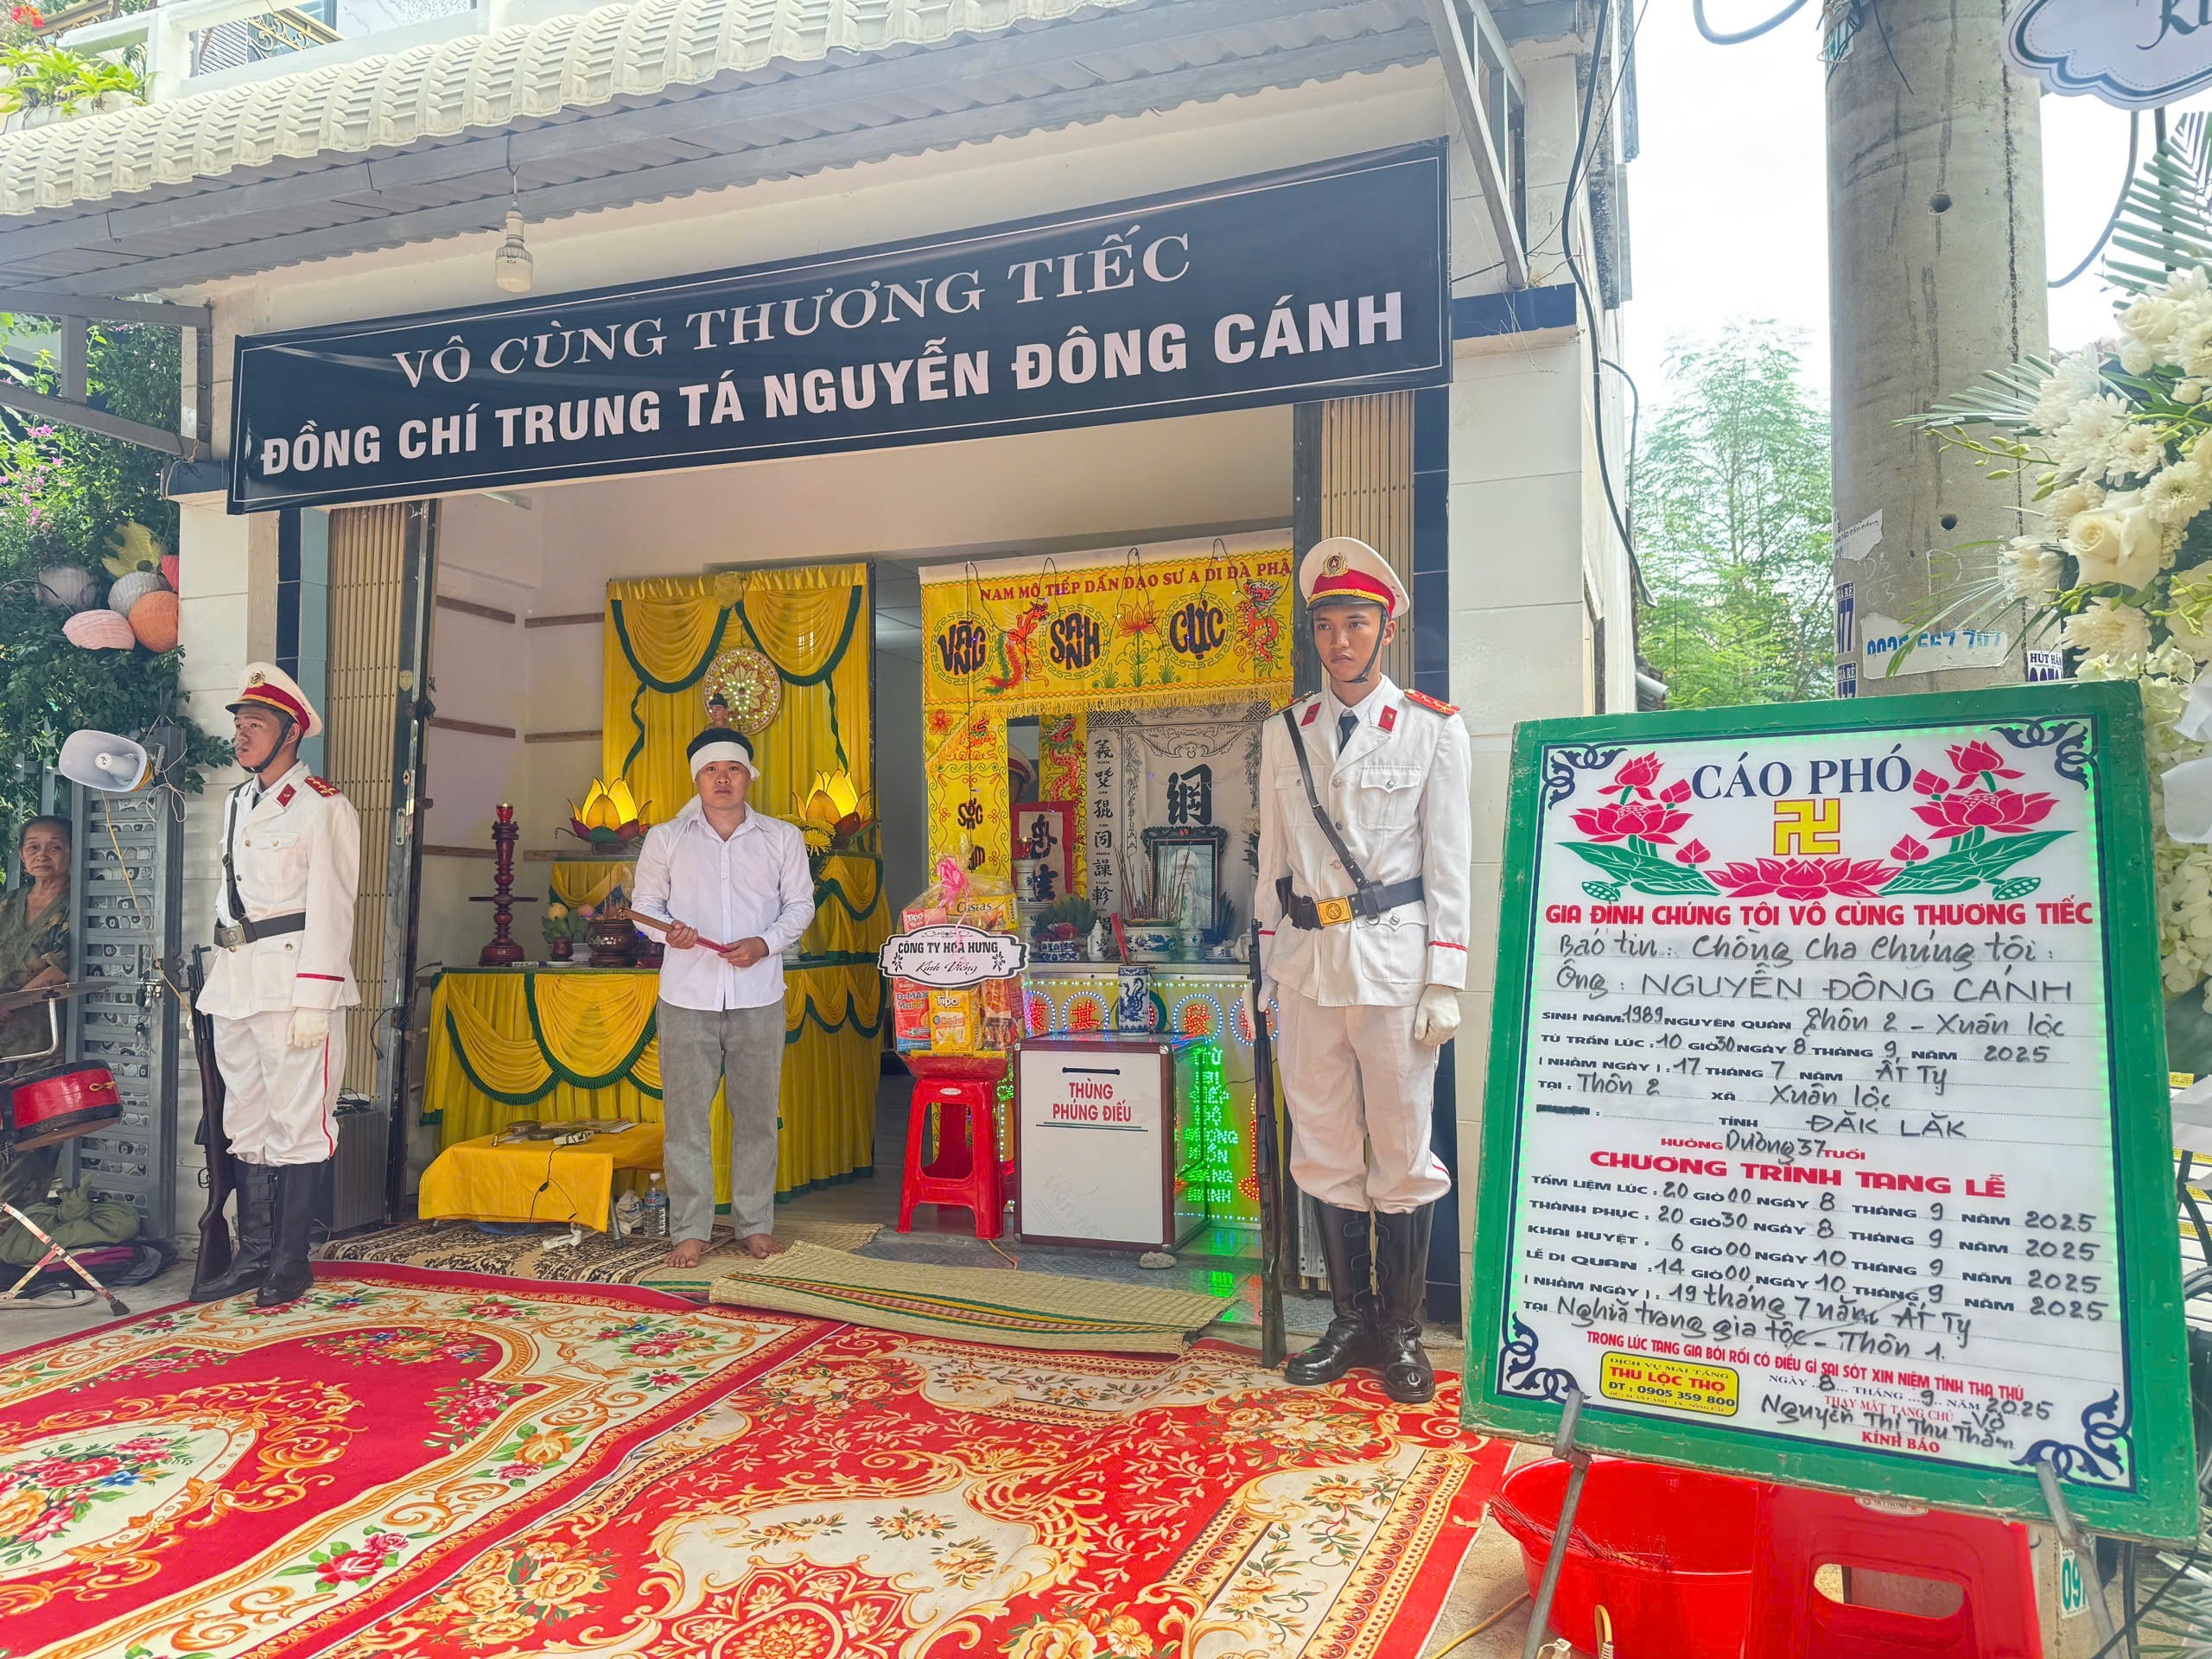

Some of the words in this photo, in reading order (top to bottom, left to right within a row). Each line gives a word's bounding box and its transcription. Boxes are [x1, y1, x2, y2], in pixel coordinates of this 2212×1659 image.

[392, 334, 469, 388] VÔ
[491, 318, 667, 375] CÙNG
[685, 270, 985, 351] THƯƠNG
[1007, 225, 1190, 304] TIẾC
[261, 419, 381, 475] ĐỒNG
[398, 404, 477, 460] CHÍ
[494, 391, 660, 448] TRUNG
[678, 370, 745, 427] TÁ
[763, 336, 989, 419] NGUYỄN
[1010, 325, 1187, 391] ĐÔNG
[1214, 291, 1402, 365] CÁNH
[981, 588, 1014, 601] NAM
[1045, 582, 1081, 596] TIẾP
[1124, 575, 1158, 591] ĐẠO
[1164, 569, 1184, 584] SƯ
[1189, 569, 1199, 583] A
[1205, 568, 1224, 582] DI
[1227, 562, 1251, 579] ĐÀ
[1257, 561, 1292, 576] PHẬ
[1169, 599, 1226, 659] CỰC
[2031, 652, 2049, 663] HÚT
[1692, 751, 1792, 799] CÁO
[1809, 744, 1911, 797] PHÓ
[906, 912, 924, 921] Tipo
[1546, 905, 1580, 924] GIA
[1590, 901, 1643, 925] ĐÌNH
[1652, 902, 1731, 925] CHÚNG
[1740, 901, 1779, 925] TÔI
[1789, 901, 1826, 925] VÔ
[1835, 901, 1904, 925] CÙNG
[1914, 902, 2025, 925] THƯƠNG
[2036, 894, 2094, 925] TIẾC
[899, 940, 924, 953] CÔNG
[927, 943, 940, 953] TY
[1560, 927, 1605, 957] Báo
[1985, 932, 2036, 962] tôi
[916, 961, 939, 976] Kính
[944, 962, 978, 975] Viếng
[1642, 963, 1802, 998] NGUYỄN
[1822, 971, 1934, 1001] ĐÔNG
[1954, 964, 2071, 1001] CÁNH
[936, 995, 958, 1006] Tipo
[1542, 1012, 1577, 1020] SINH
[1623, 1004, 1663, 1024] 1989
[1664, 1017, 1734, 1028] NGUYÊN
[1741, 1019, 1791, 1029] QUÁN
[1884, 1012, 1897, 1032] 2
[1936, 1013, 2008, 1035] Xuân
[1614, 1036, 1644, 1047] LÚC
[1656, 1033, 1682, 1050] 10
[1718, 1036, 1734, 1052] 30
[1737, 1043, 1787, 1054] NGÀY
[1793, 1038, 1805, 1054] 8
[1812, 1046, 1873, 1058] THÁNG
[1885, 1041, 1897, 1057] 9
[1911, 1050, 1957, 1060] NĂM
[1985, 1046, 2050, 1063] 2025
[1602, 1061, 1649, 1071] NGÀY
[1673, 1058, 1700, 1076] 17
[1705, 1067, 1763, 1077] THÁNG
[1771, 1061, 1784, 1079] 7
[1799, 1071, 1843, 1081] NĂM
[1069, 1078, 1113, 1099] THÙNG
[1578, 1073, 1632, 1093] Thôn
[1647, 1078, 1660, 1096] 2
[1770, 1083, 1838, 1105] Xuân
[1052, 1099, 1098, 1121] PHÚNG
[1103, 1099, 1132, 1122] ĐIẾU
[1797, 1138, 1826, 1158] 37
[1590, 1151, 1727, 1176] CHƯƠNG
[1740, 1160, 1842, 1186] TRÌNH
[1855, 1172, 1951, 1193] TANG
[1965, 1174, 2005, 1198] LỄ
[1573, 1179, 1611, 1192] LIỆM
[1617, 1183, 1648, 1195] LÚC
[1662, 1181, 1688, 1198] 20
[1728, 1187, 1751, 1205] 00
[1757, 1197, 1809, 1210] NGÀY
[1819, 1192, 1834, 1211] 8
[1852, 1205, 1917, 1218] THÁNG
[1930, 1203, 1943, 1221] 9
[1961, 1213, 2011, 1226] NĂM
[2024, 1211, 2096, 1232] 2025
[1523, 1301, 1548, 1313] TẠI
[1636, 1301, 1707, 1338] trang
[1713, 1316, 1756, 1341] gia
[1838, 1332, 1910, 1357] Thôn
[1587, 1331, 1624, 1348] TRONG
[1628, 1334, 1647, 1351] LÚC
[1651, 1339, 1680, 1355] TANG
[1684, 1344, 1702, 1358] GIA
[1753, 1351, 1770, 1368] CÓ
[1821, 1363, 1839, 1378] SAI
[1843, 1365, 1866, 1381] SÓT
[1872, 1369, 1894, 1384] XIN
[1968, 1381, 1993, 1397] THA
[1609, 1382, 1625, 1390] ĐT
[1637, 1385, 1672, 1397] 0905
[1677, 1391, 1702, 1402] 359
[1707, 1395, 1735, 1408] 800
[1610, 1366, 1642, 1380] THU
[1648, 1372, 1682, 1386] LỘC
[1688, 1378, 1726, 1395] THỌ
[1862, 1431, 1902, 1448] KÍNH
[1907, 1439, 1941, 1453] BÁO
